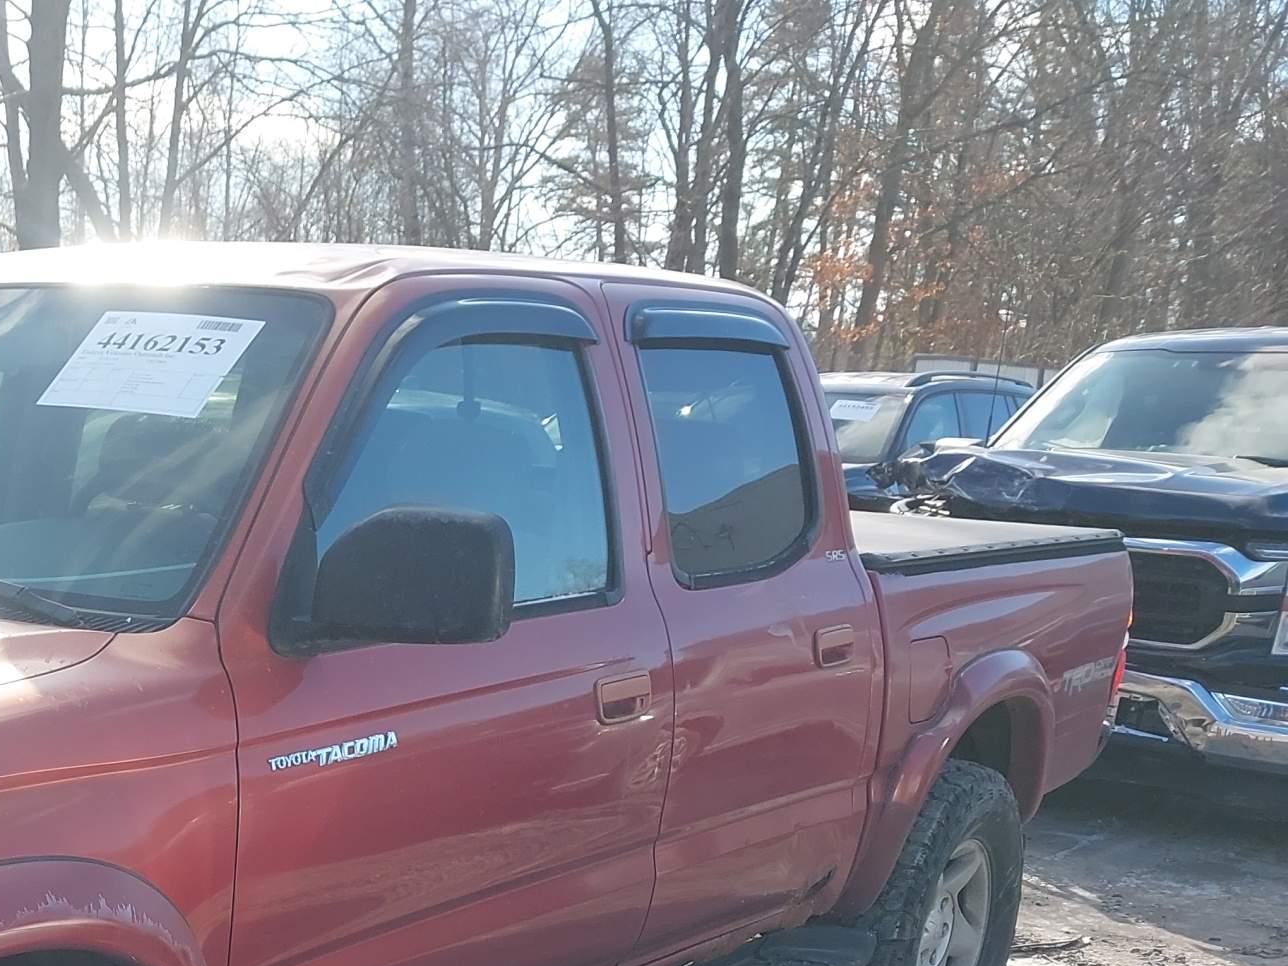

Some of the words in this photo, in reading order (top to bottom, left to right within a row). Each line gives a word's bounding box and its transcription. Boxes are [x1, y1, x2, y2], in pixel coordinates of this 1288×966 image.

[97, 331, 226, 356] 44162153
[269, 751, 315, 771] TOYOTA
[314, 731, 398, 766] TACOMA
